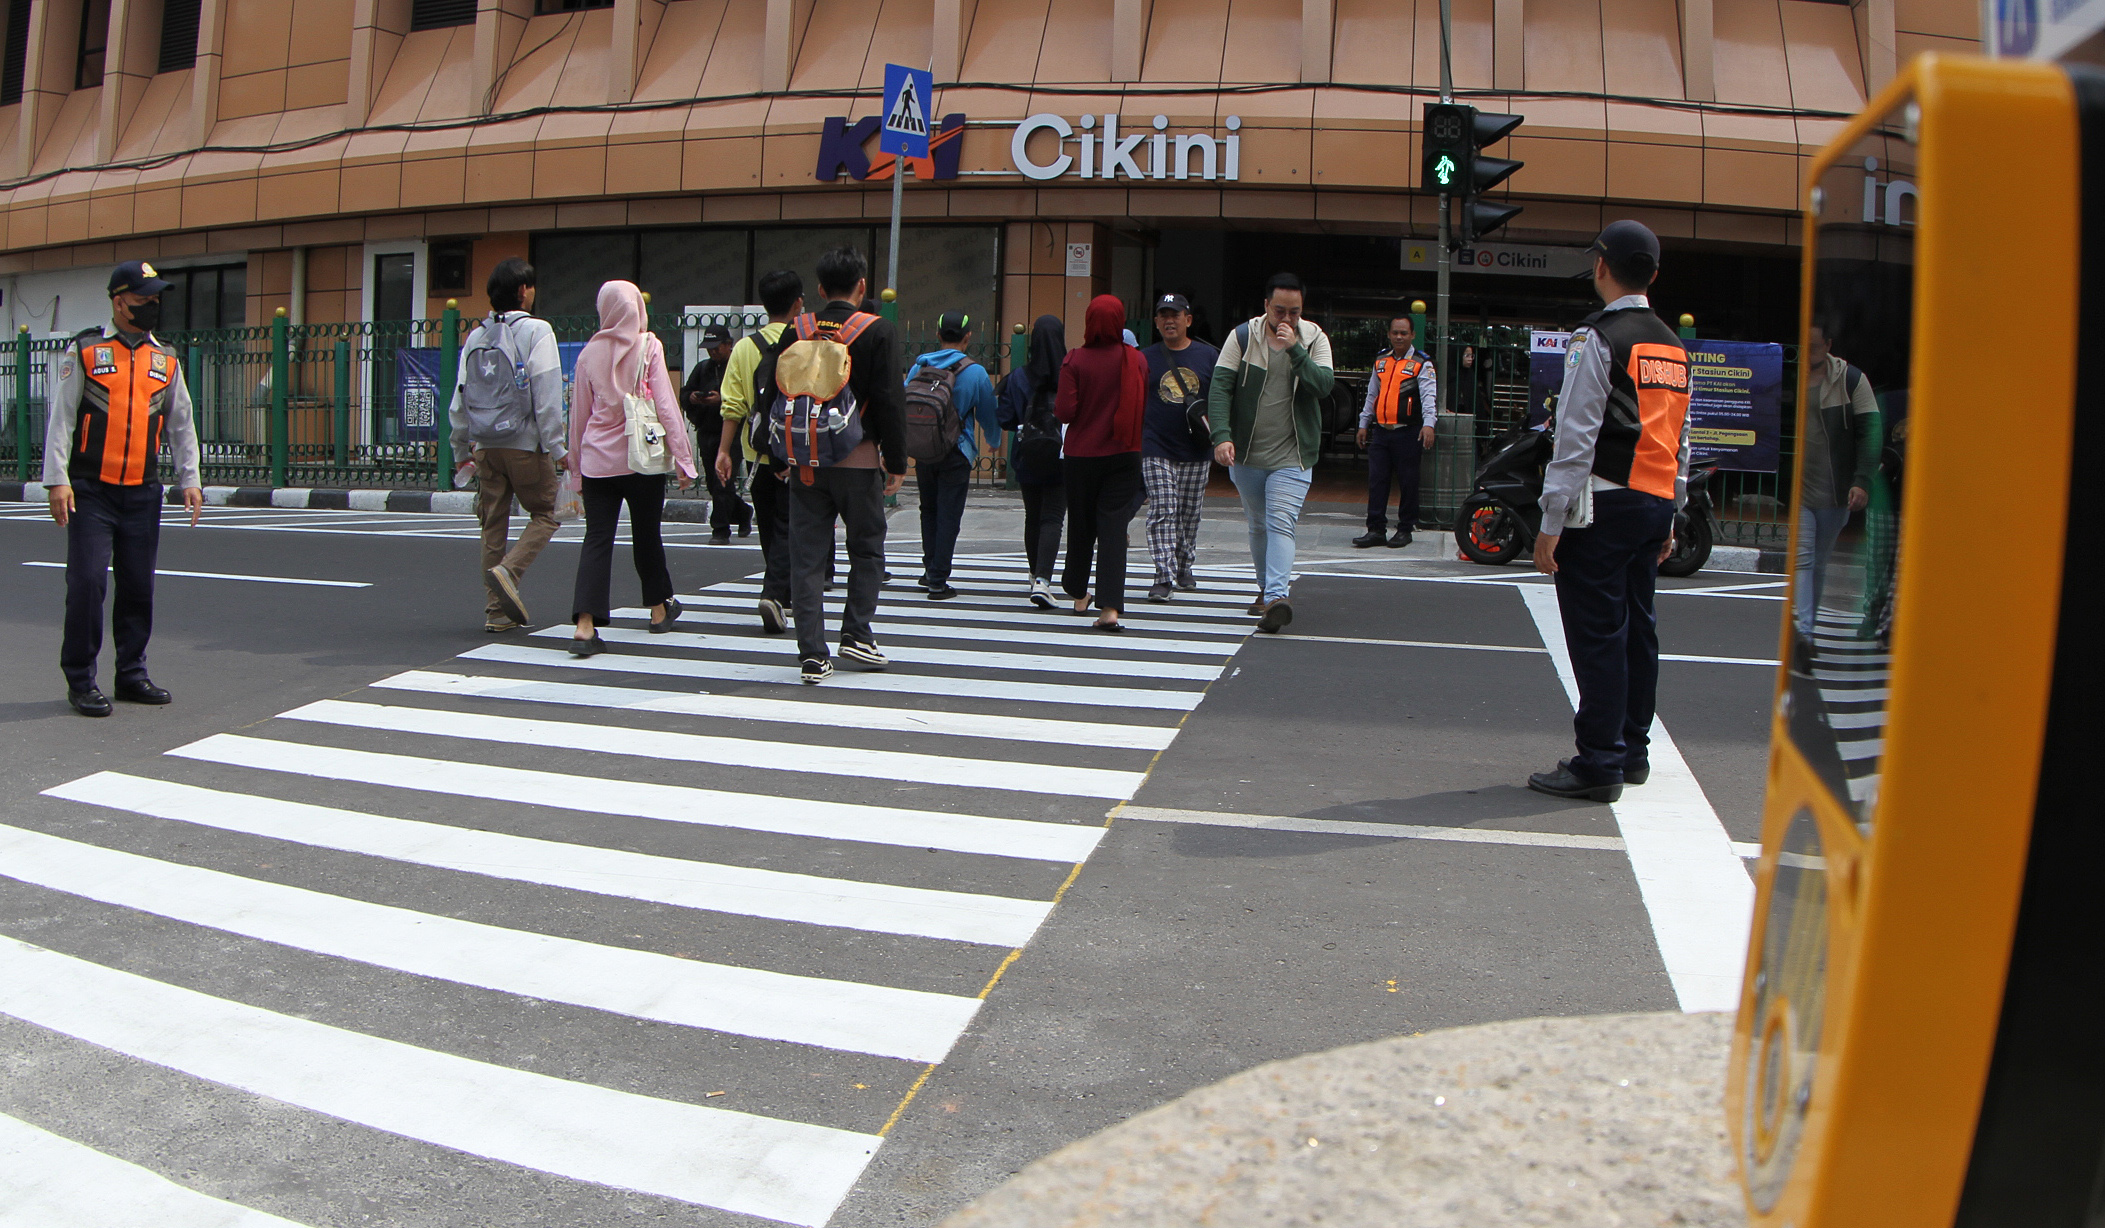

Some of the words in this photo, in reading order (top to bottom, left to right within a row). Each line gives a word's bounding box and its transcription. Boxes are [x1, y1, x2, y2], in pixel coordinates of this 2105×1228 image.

[1012, 113, 1241, 181] Cikini
[1497, 252, 1546, 268] Cikini
[1688, 352, 1726, 364] NTING
[1640, 359, 1687, 388] DISHUB
